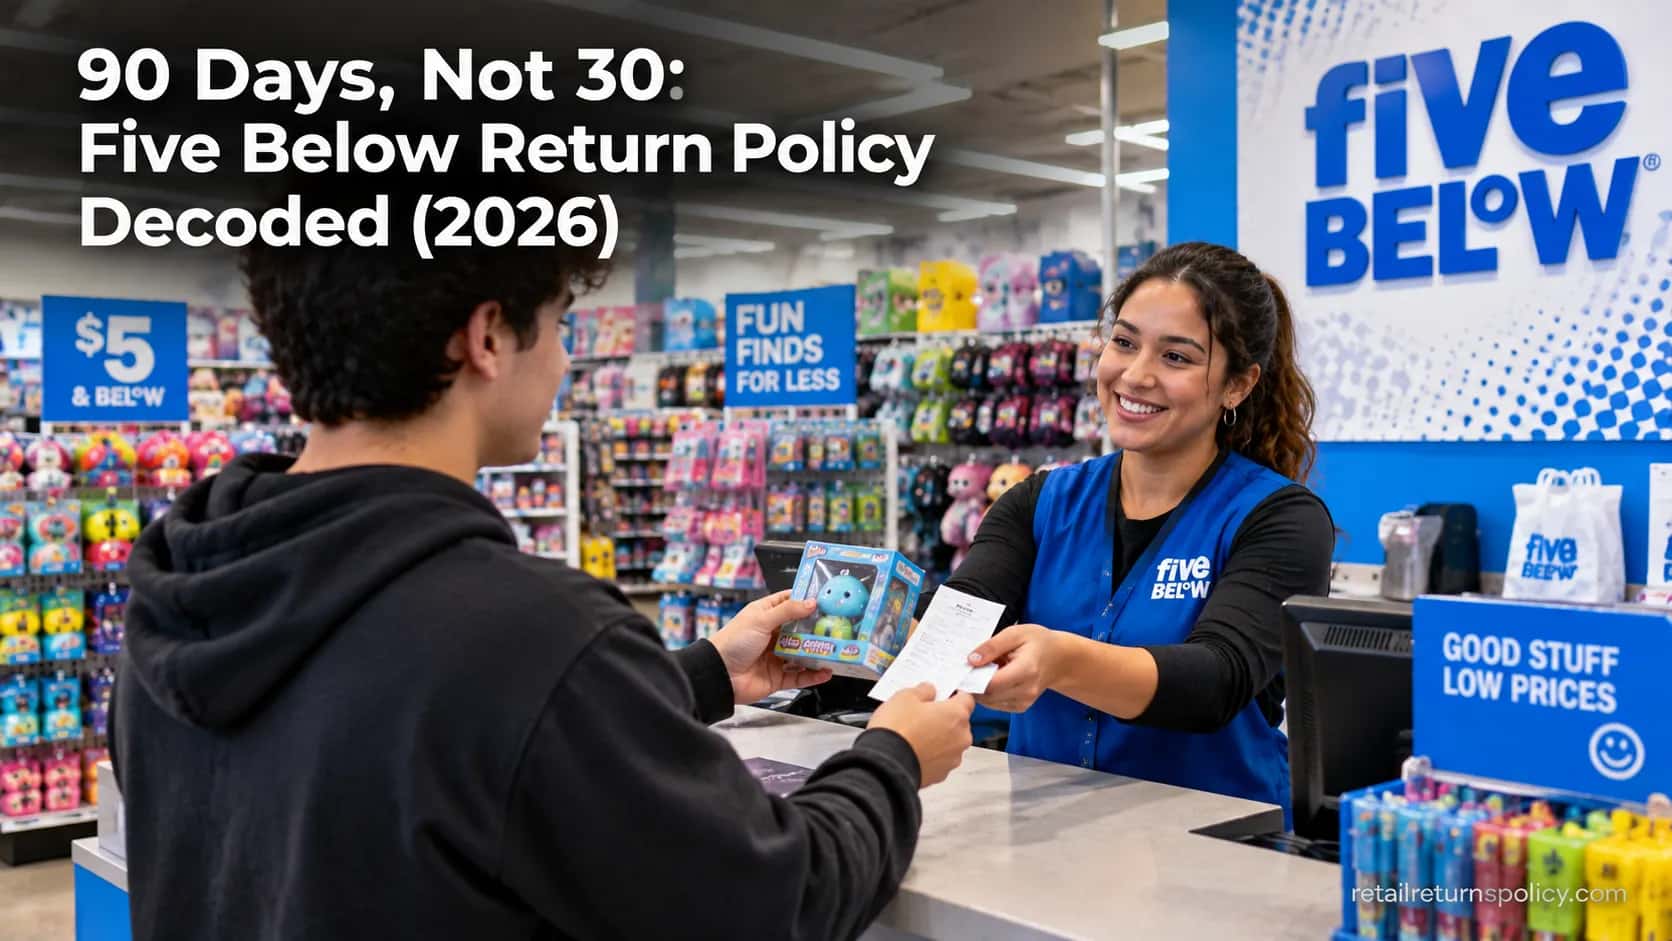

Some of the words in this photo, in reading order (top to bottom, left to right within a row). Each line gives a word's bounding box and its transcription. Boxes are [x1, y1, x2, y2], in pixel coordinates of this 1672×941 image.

[1305, 21, 1628, 187] five
[736, 300, 804, 335] FUN
[75, 311, 155, 383] $5
[736, 334, 824, 365] FINDS
[71, 386, 90, 406] &
[736, 370, 780, 393] FOR
[785, 367, 840, 391] LESS
[1157, 555, 1210, 581] five
[1443, 632, 1520, 667] GOOD
[1528, 639, 1619, 676] STUFF
[1443, 666, 1503, 700] LOW
[1511, 673, 1617, 714] PRICES
